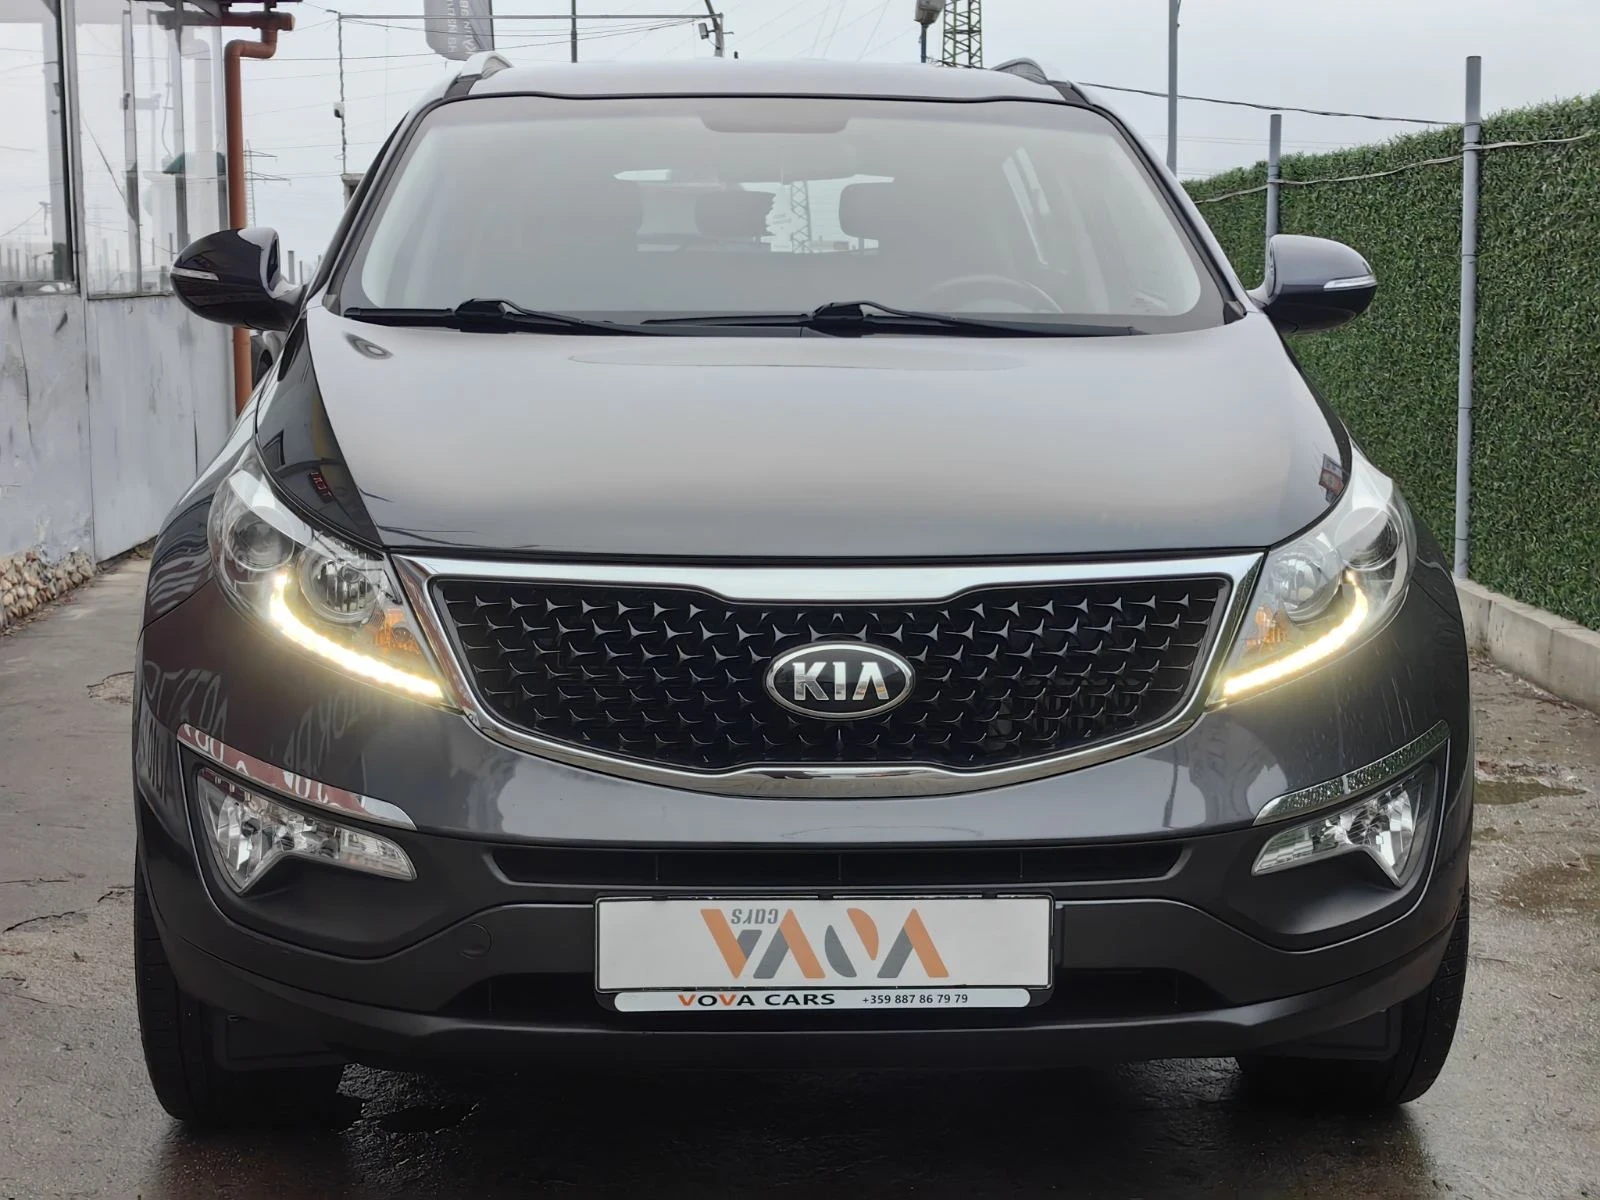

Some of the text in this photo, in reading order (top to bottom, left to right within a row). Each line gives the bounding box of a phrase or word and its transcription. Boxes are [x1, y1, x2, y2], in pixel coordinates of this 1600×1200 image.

[792, 661, 890, 701] KIA
[678, 993, 968, 1007] VOVA CARS +359 887 86 79 79
